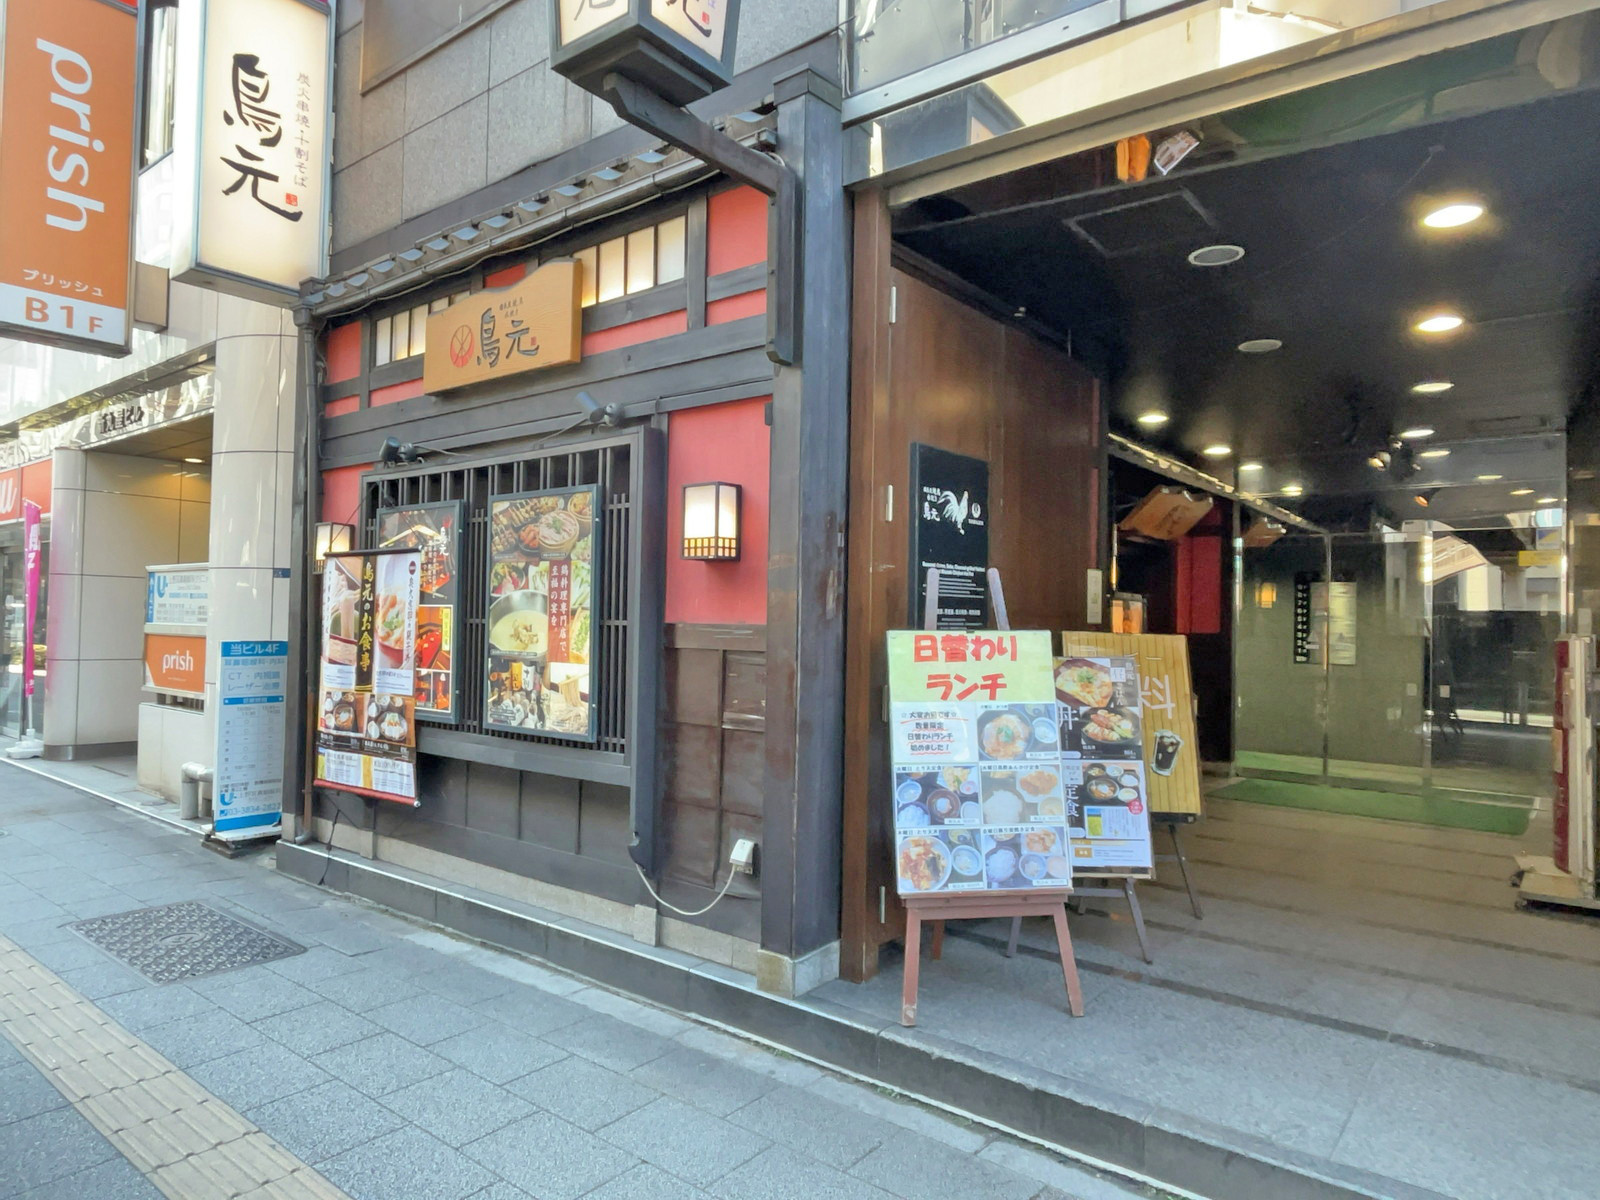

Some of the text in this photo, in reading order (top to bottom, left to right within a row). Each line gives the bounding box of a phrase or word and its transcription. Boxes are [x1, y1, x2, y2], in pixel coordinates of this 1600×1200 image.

[36, 37, 105, 232] prish
[220, 53, 303, 222] 鳥元
[22, 268, 104, 297] プリッシュ
[24, 296, 104, 334] B1F
[477, 307, 540, 368] 鳥元
[359, 561, 374, 672] 鳥元のお食事
[162, 650, 194, 674] prish
[229, 643, 280, 655] 当ビル4F
[914, 634, 1018, 662] 日替わり
[926, 673, 1007, 700] ランチ
